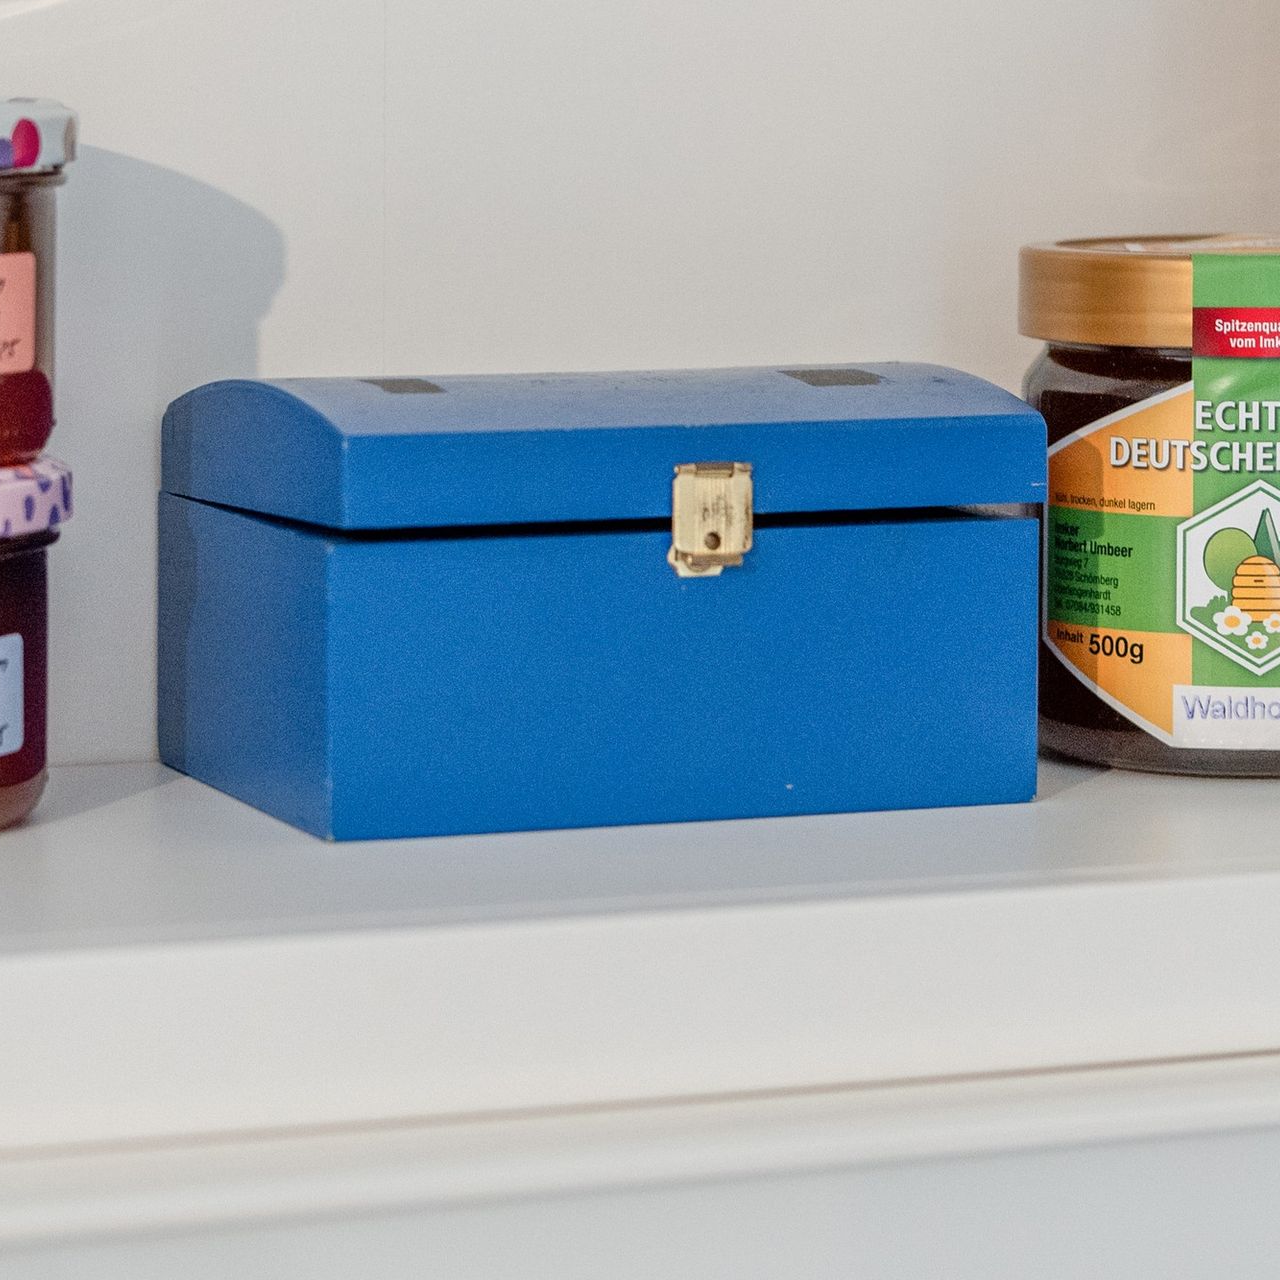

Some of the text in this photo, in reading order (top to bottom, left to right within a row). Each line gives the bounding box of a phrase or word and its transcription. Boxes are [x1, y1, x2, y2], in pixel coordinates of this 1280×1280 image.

[1229, 337, 1255, 349] vom
[1099, 497, 1126, 509] dunkel
[1128, 499, 1156, 512] lagern
[1090, 541, 1133, 558] Umbeer
[1057, 629, 1144, 664] Inhalt 500g
